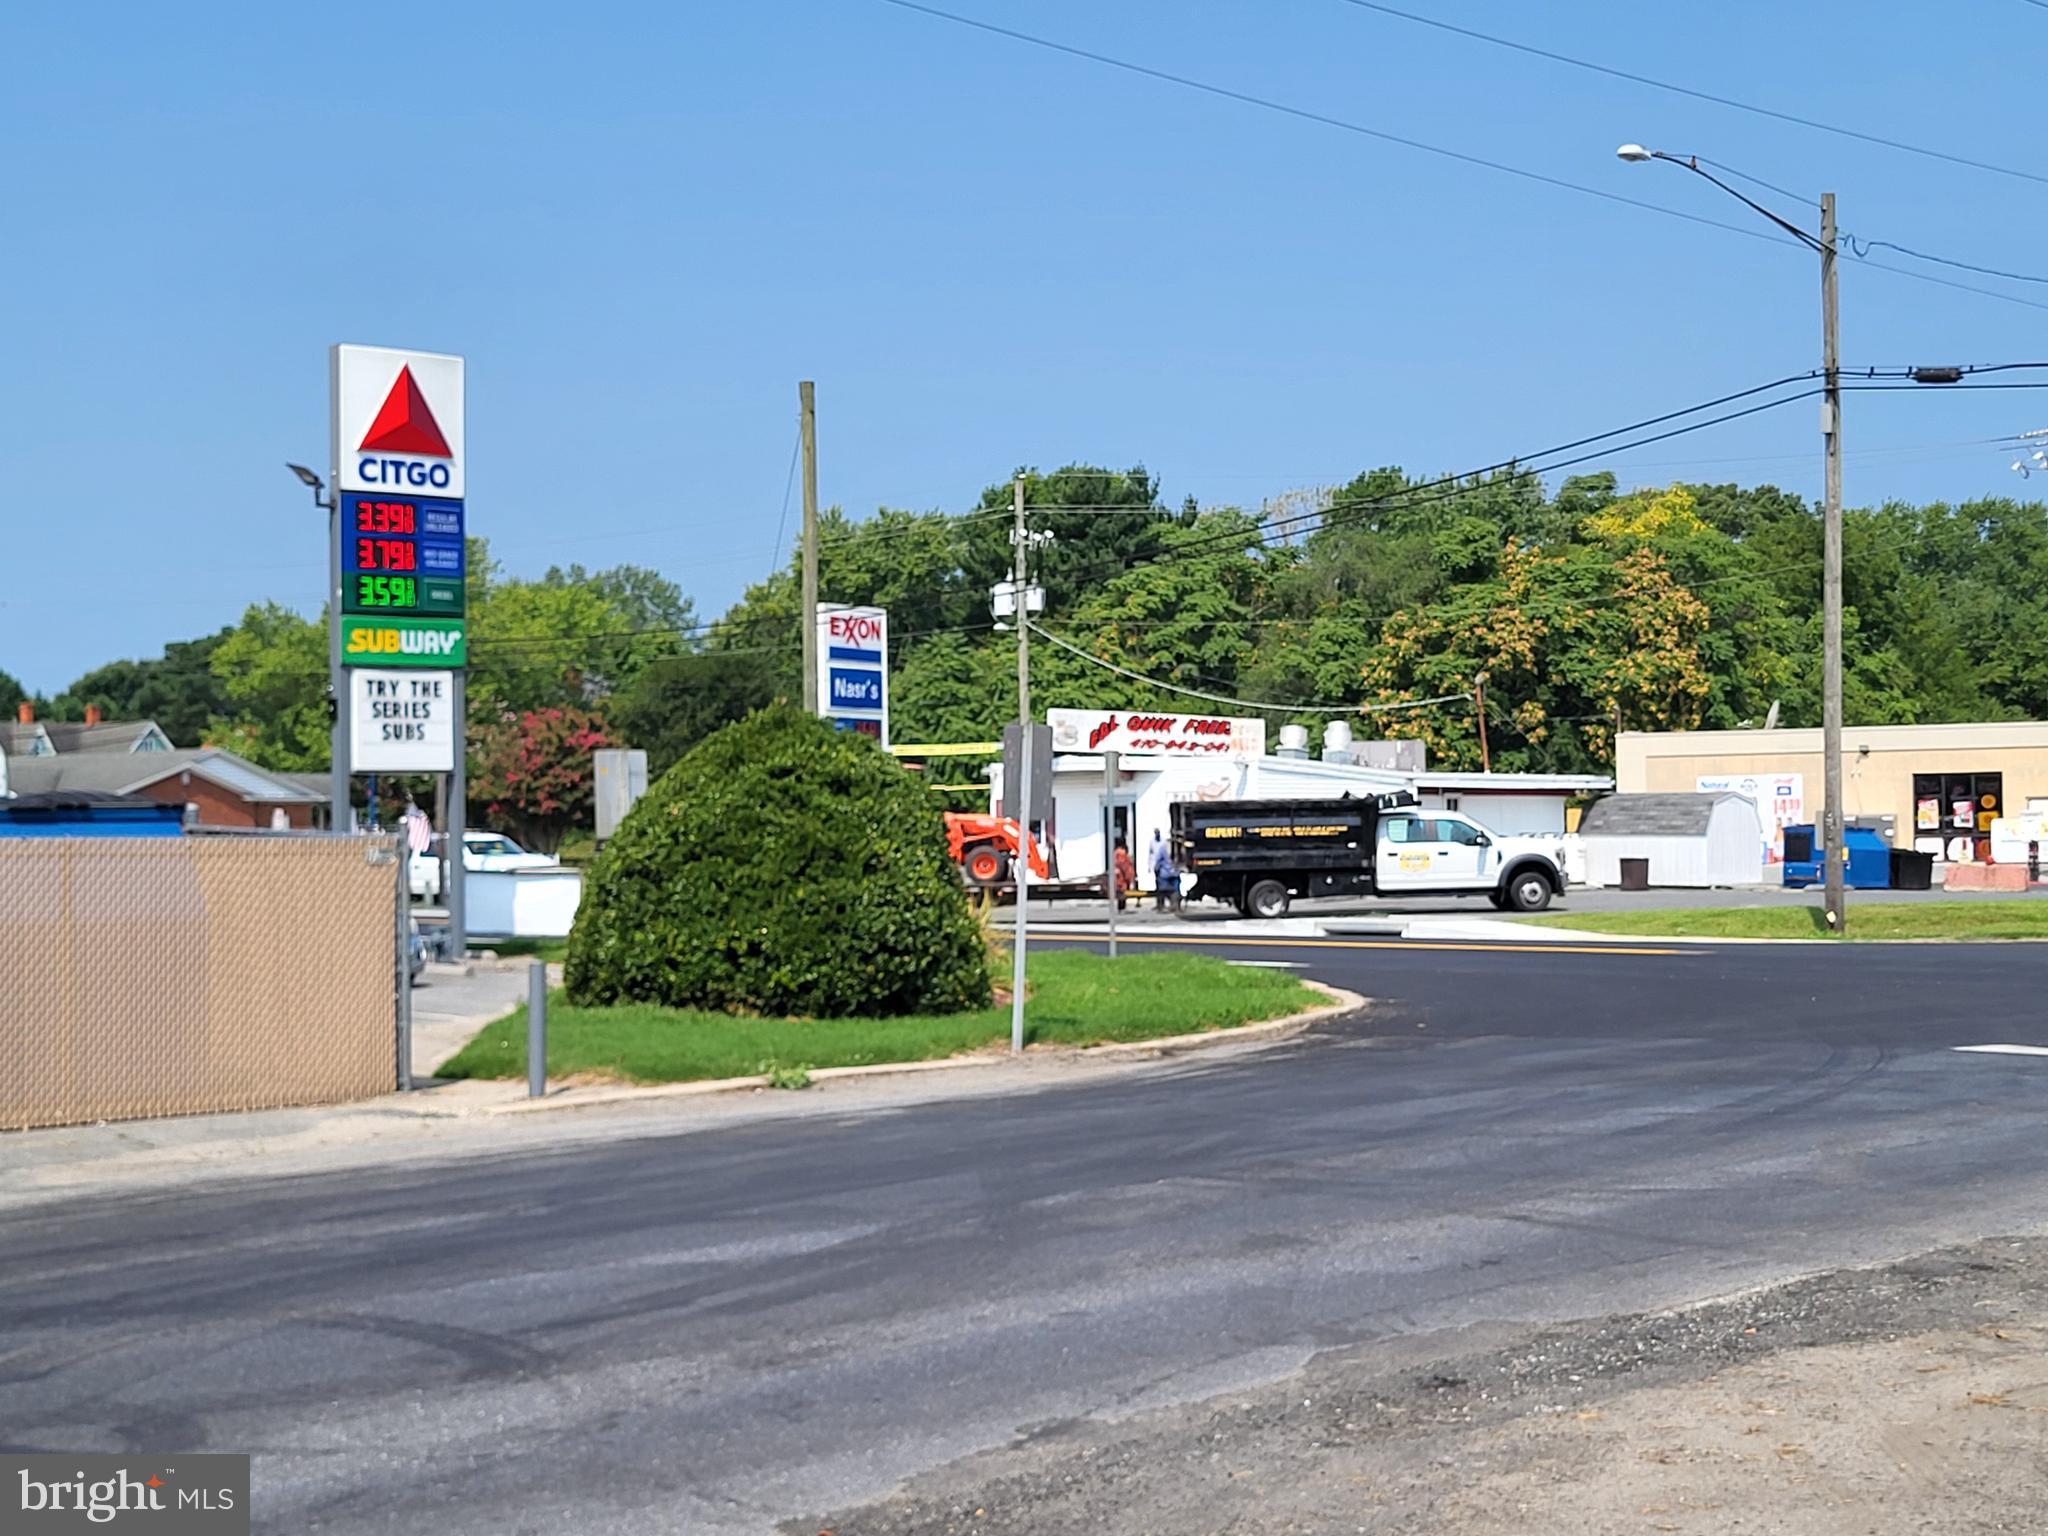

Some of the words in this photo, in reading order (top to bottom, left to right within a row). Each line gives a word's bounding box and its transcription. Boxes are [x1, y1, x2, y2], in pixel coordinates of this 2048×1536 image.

[358, 458, 450, 489] CITGO
[346, 627, 462, 655] SUBWAY
[830, 616, 881, 648] EXXON
[366, 679, 400, 697] TRY
[410, 680, 443, 698] THE
[371, 701, 431, 719] SERIES
[381, 723, 426, 741] SUBS
